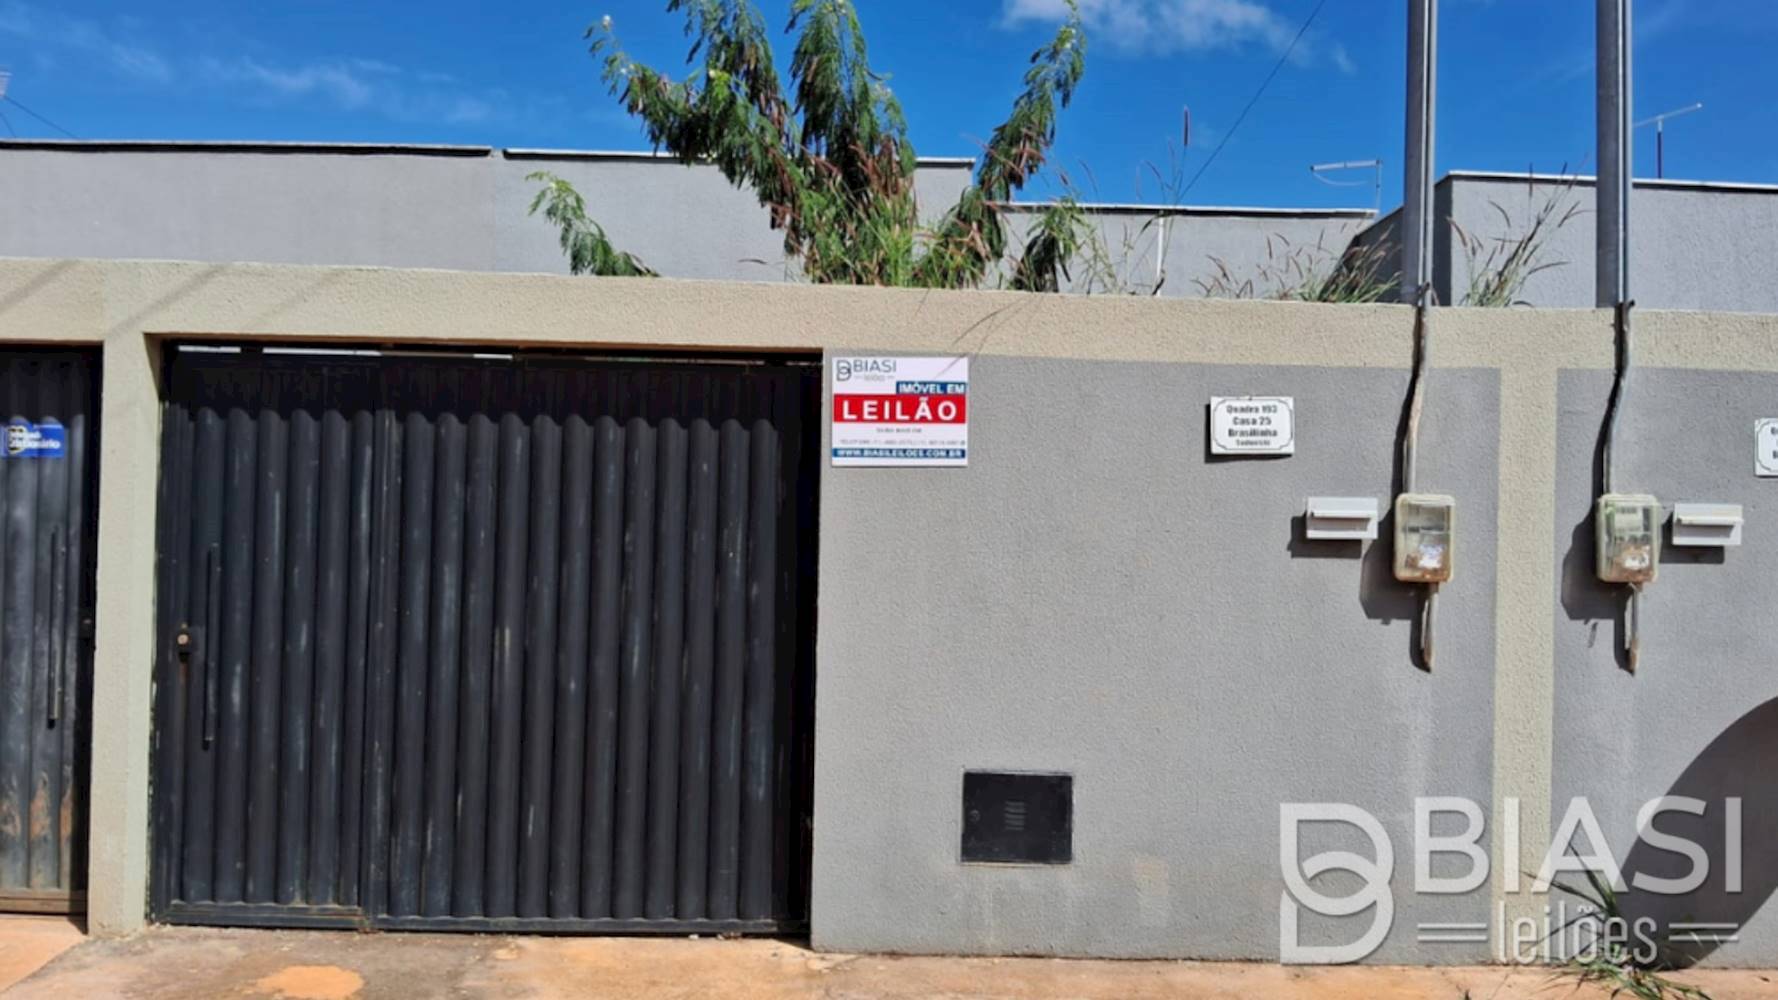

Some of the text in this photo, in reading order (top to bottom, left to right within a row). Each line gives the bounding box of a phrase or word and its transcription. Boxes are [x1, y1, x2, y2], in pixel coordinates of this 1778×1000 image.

[853, 359, 897, 373] BIASI
[898, 381, 965, 394] IMÓVEL EM
[842, 396, 957, 421] LEILÃO
[1232, 416, 1272, 426] Casa 25
